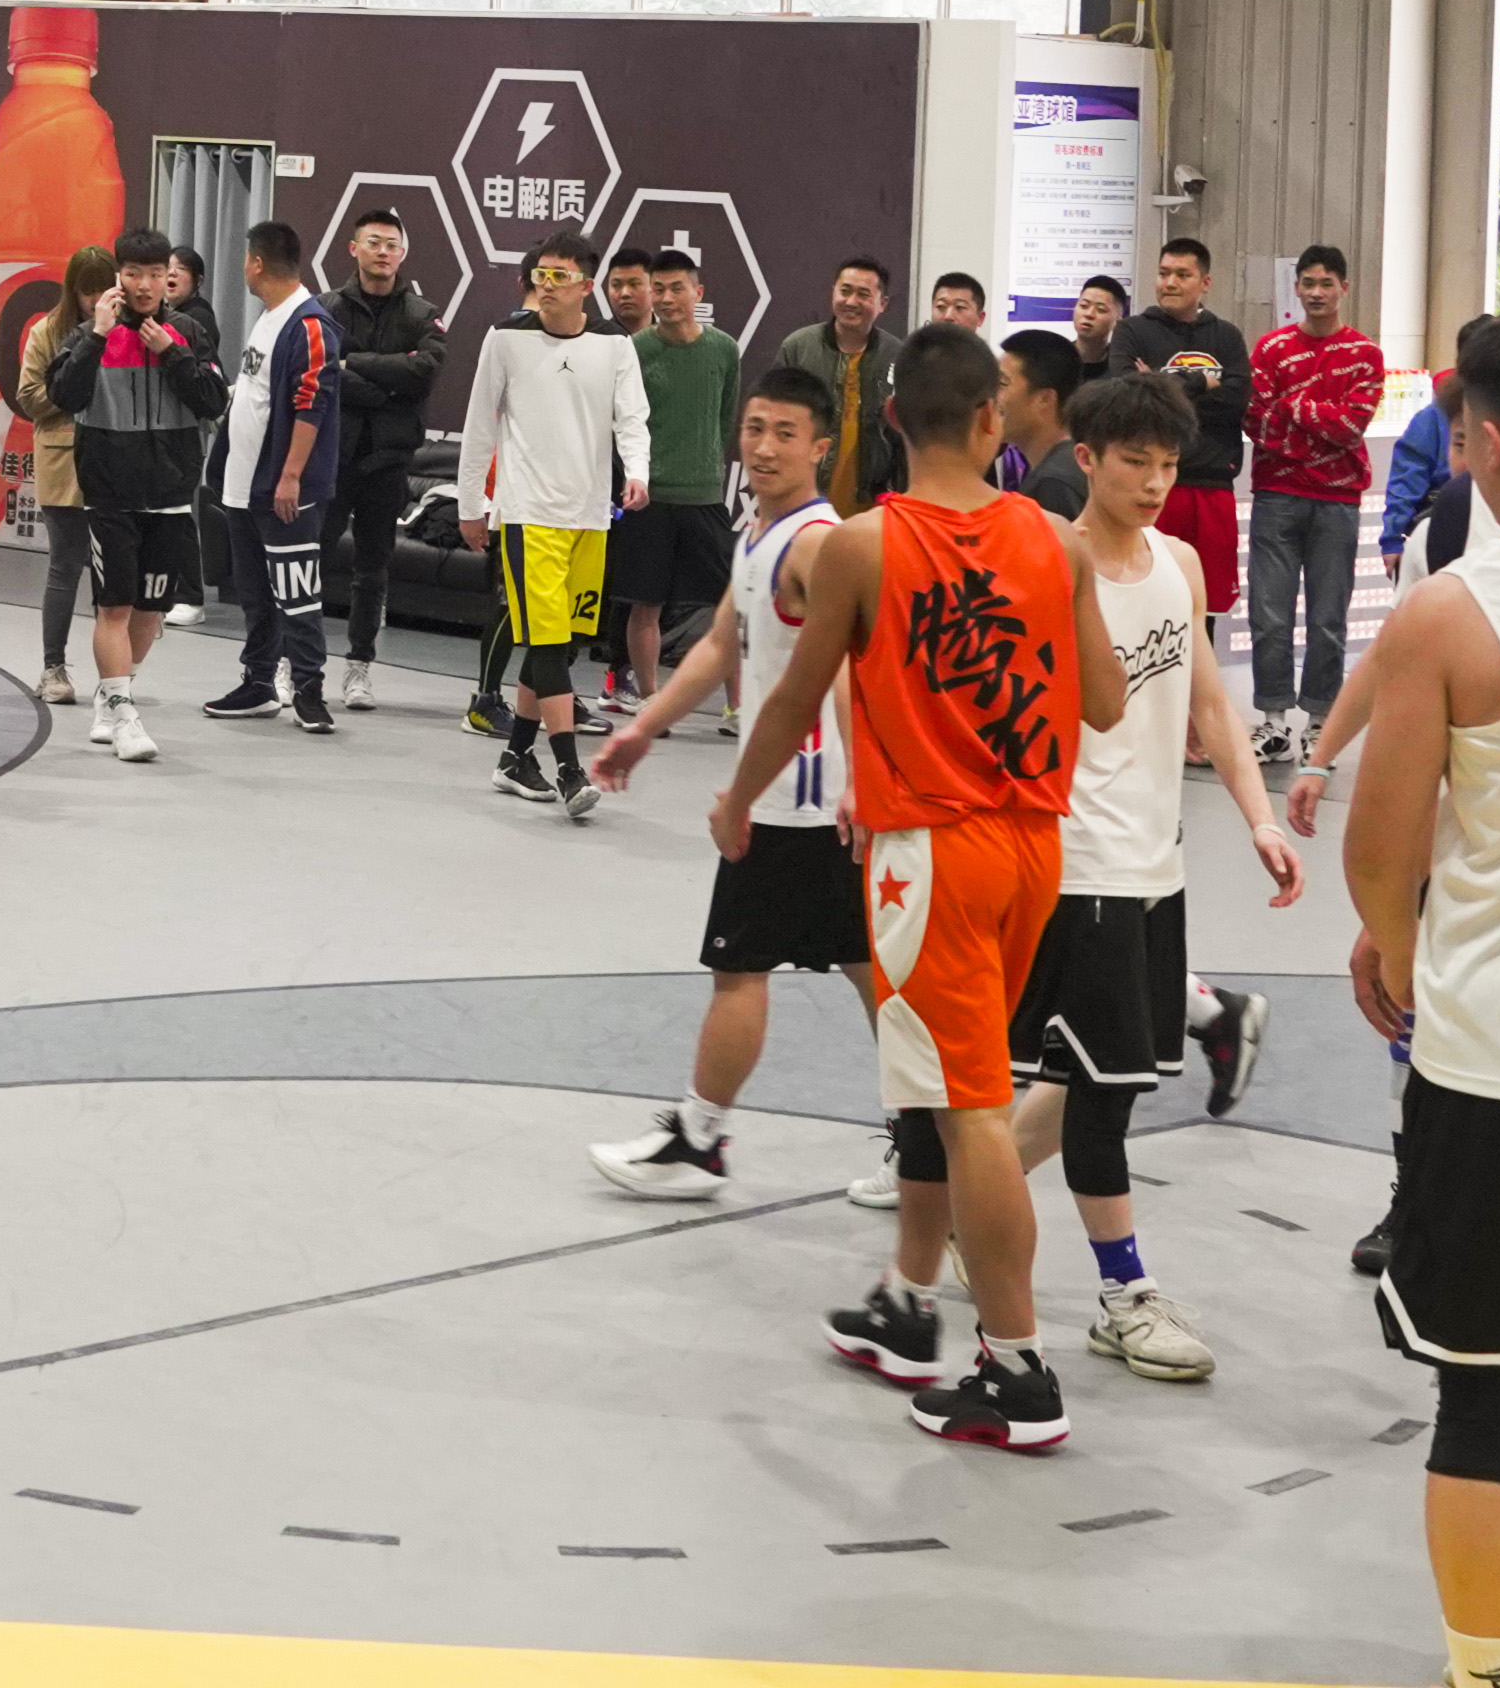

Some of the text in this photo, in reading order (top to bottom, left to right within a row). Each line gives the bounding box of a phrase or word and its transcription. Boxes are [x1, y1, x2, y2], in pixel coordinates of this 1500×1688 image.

[483, 175, 585, 222] 电解质
[145, 573, 168, 598] 10
[571, 589, 599, 620] 12
